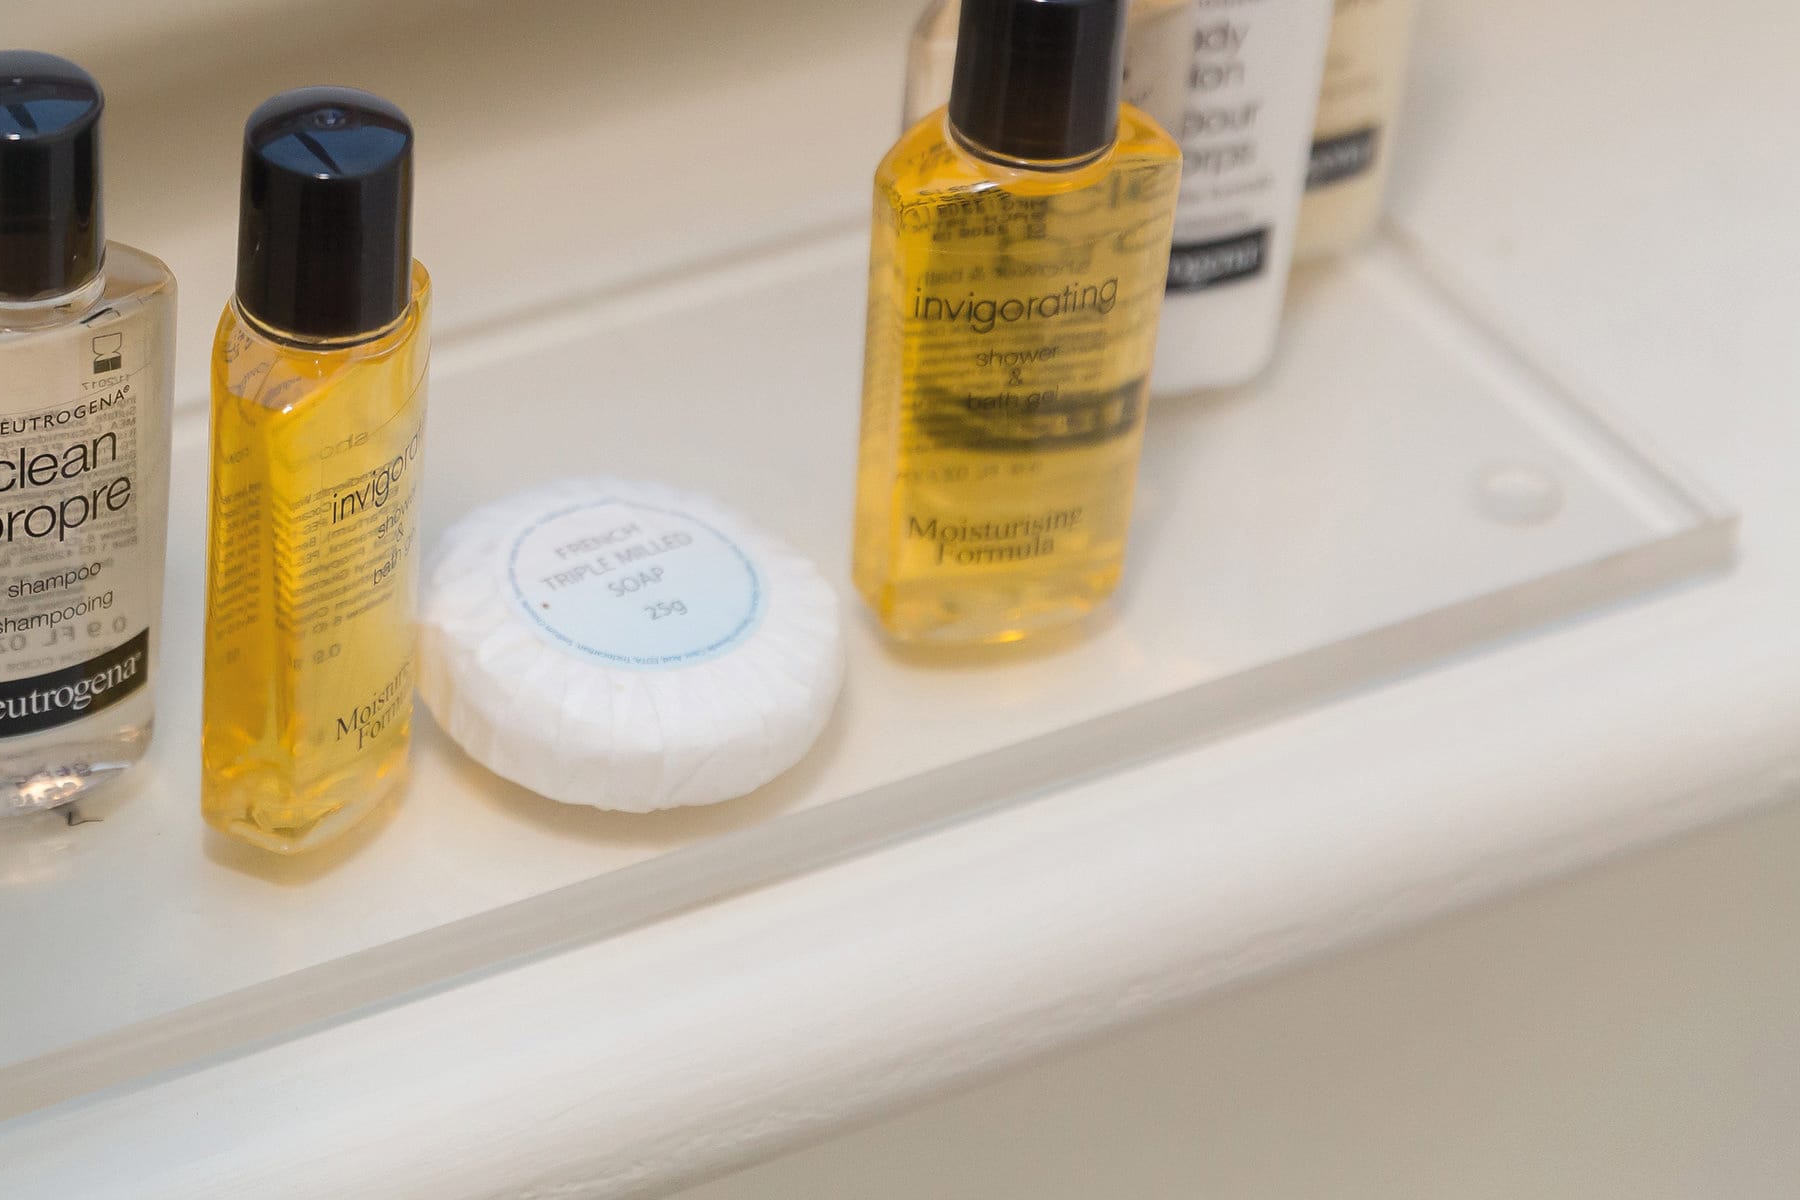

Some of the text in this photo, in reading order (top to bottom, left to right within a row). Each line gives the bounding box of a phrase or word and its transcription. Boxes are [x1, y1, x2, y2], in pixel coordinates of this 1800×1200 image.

[915, 277, 1119, 335] invigorating
[975, 345, 1060, 367] shower
[1008, 367, 1023, 386] &
[554, 522, 642, 560] FRENCH
[539, 531, 694, 591] TRIPLE MILLED
[8, 561, 102, 599] shampoo
[607, 566, 664, 598] SOAP
[643, 599, 689, 621] 25g
